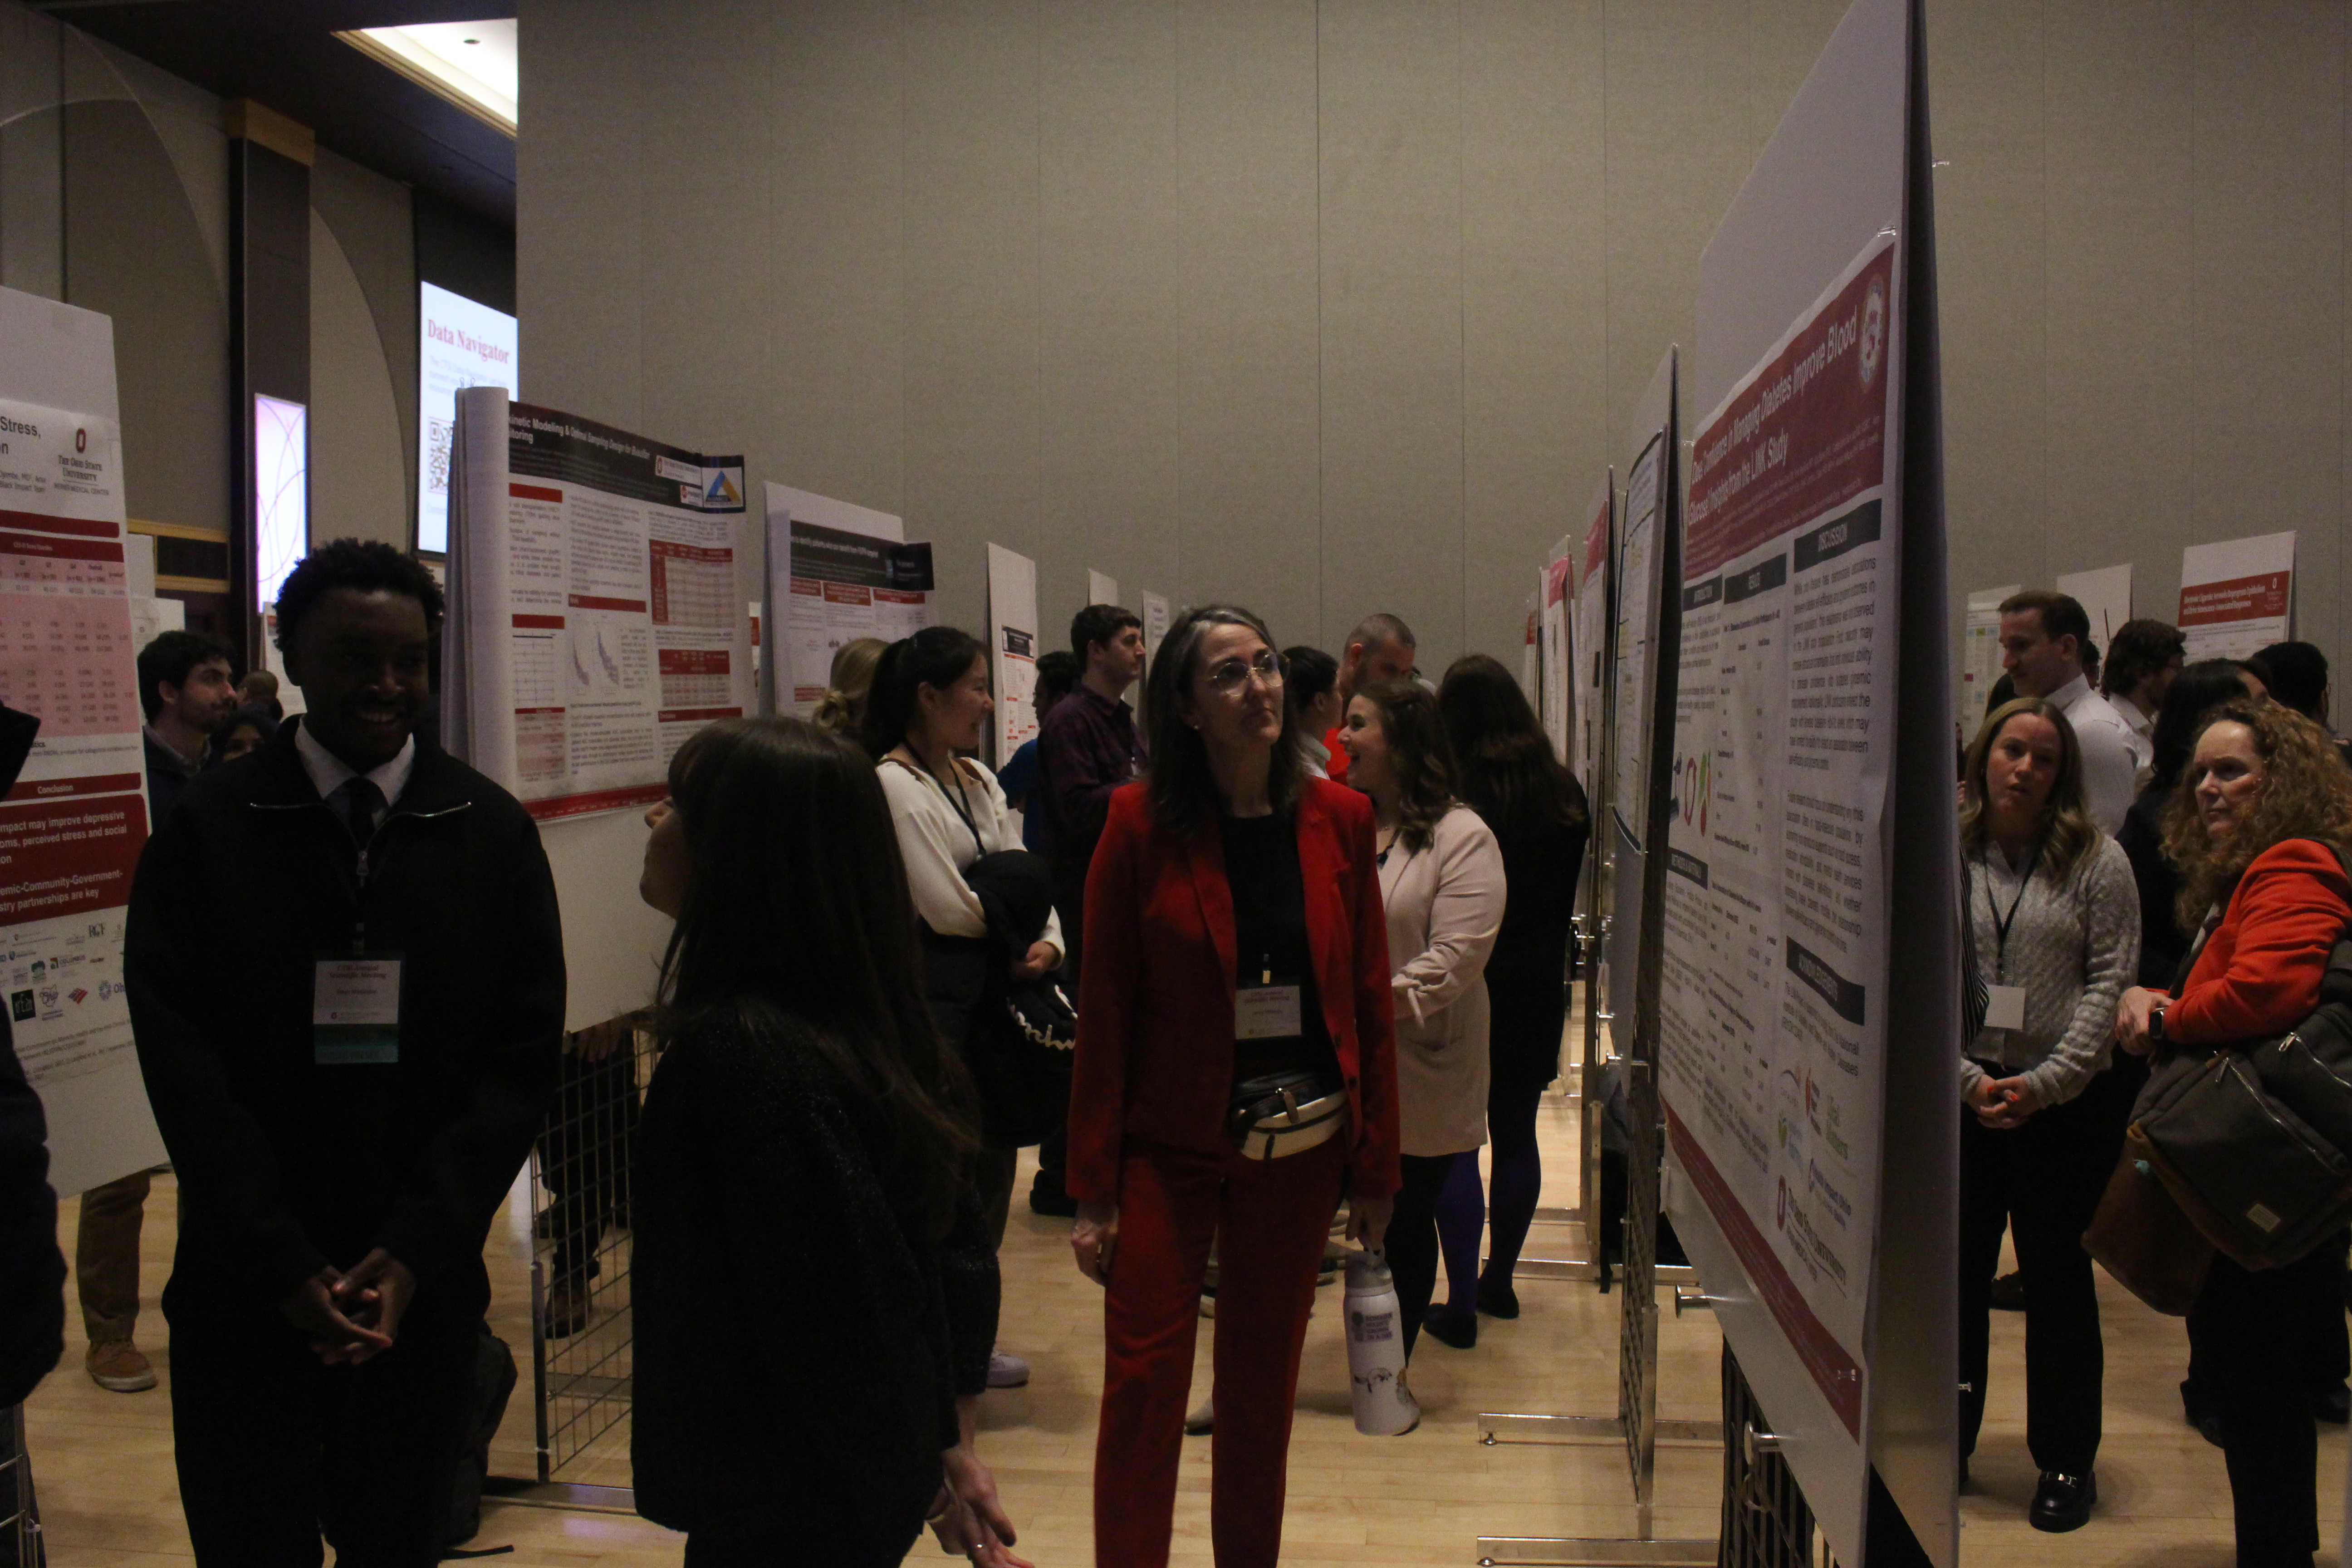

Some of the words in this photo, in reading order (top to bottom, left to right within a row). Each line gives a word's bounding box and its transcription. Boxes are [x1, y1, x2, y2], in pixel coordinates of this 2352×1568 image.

[428, 319, 454, 345] Data
[457, 328, 510, 366] Navigator
[1734, 403, 1760, 447] Managing
[1761, 374, 1792, 422] Diabetes
[1793, 342, 1825, 397] Improve
[1827, 304, 1857, 363] Blood
[0, 416, 41, 439] Stress,
[533, 417, 564, 437] Modeling
[0, 443, 9, 454] n
[1751, 441, 1766, 480] LINK
[1767, 427, 1788, 469] Study
[37, 784, 74, 794] Conclusion
[29, 820, 46, 830] may
[49, 816, 82, 828] improve
[83, 811, 125, 825] depressive
[0, 838, 21, 848] oms,
[23, 834, 60, 848] perceived
[62, 830, 87, 841] stress
[88, 827, 103, 837] and
[104, 824, 127, 836] social
[0, 855, 12, 864] on
[18, 892, 69, 911] partnerships
[71, 891, 83, 900] are
[85, 888, 99, 899] key
